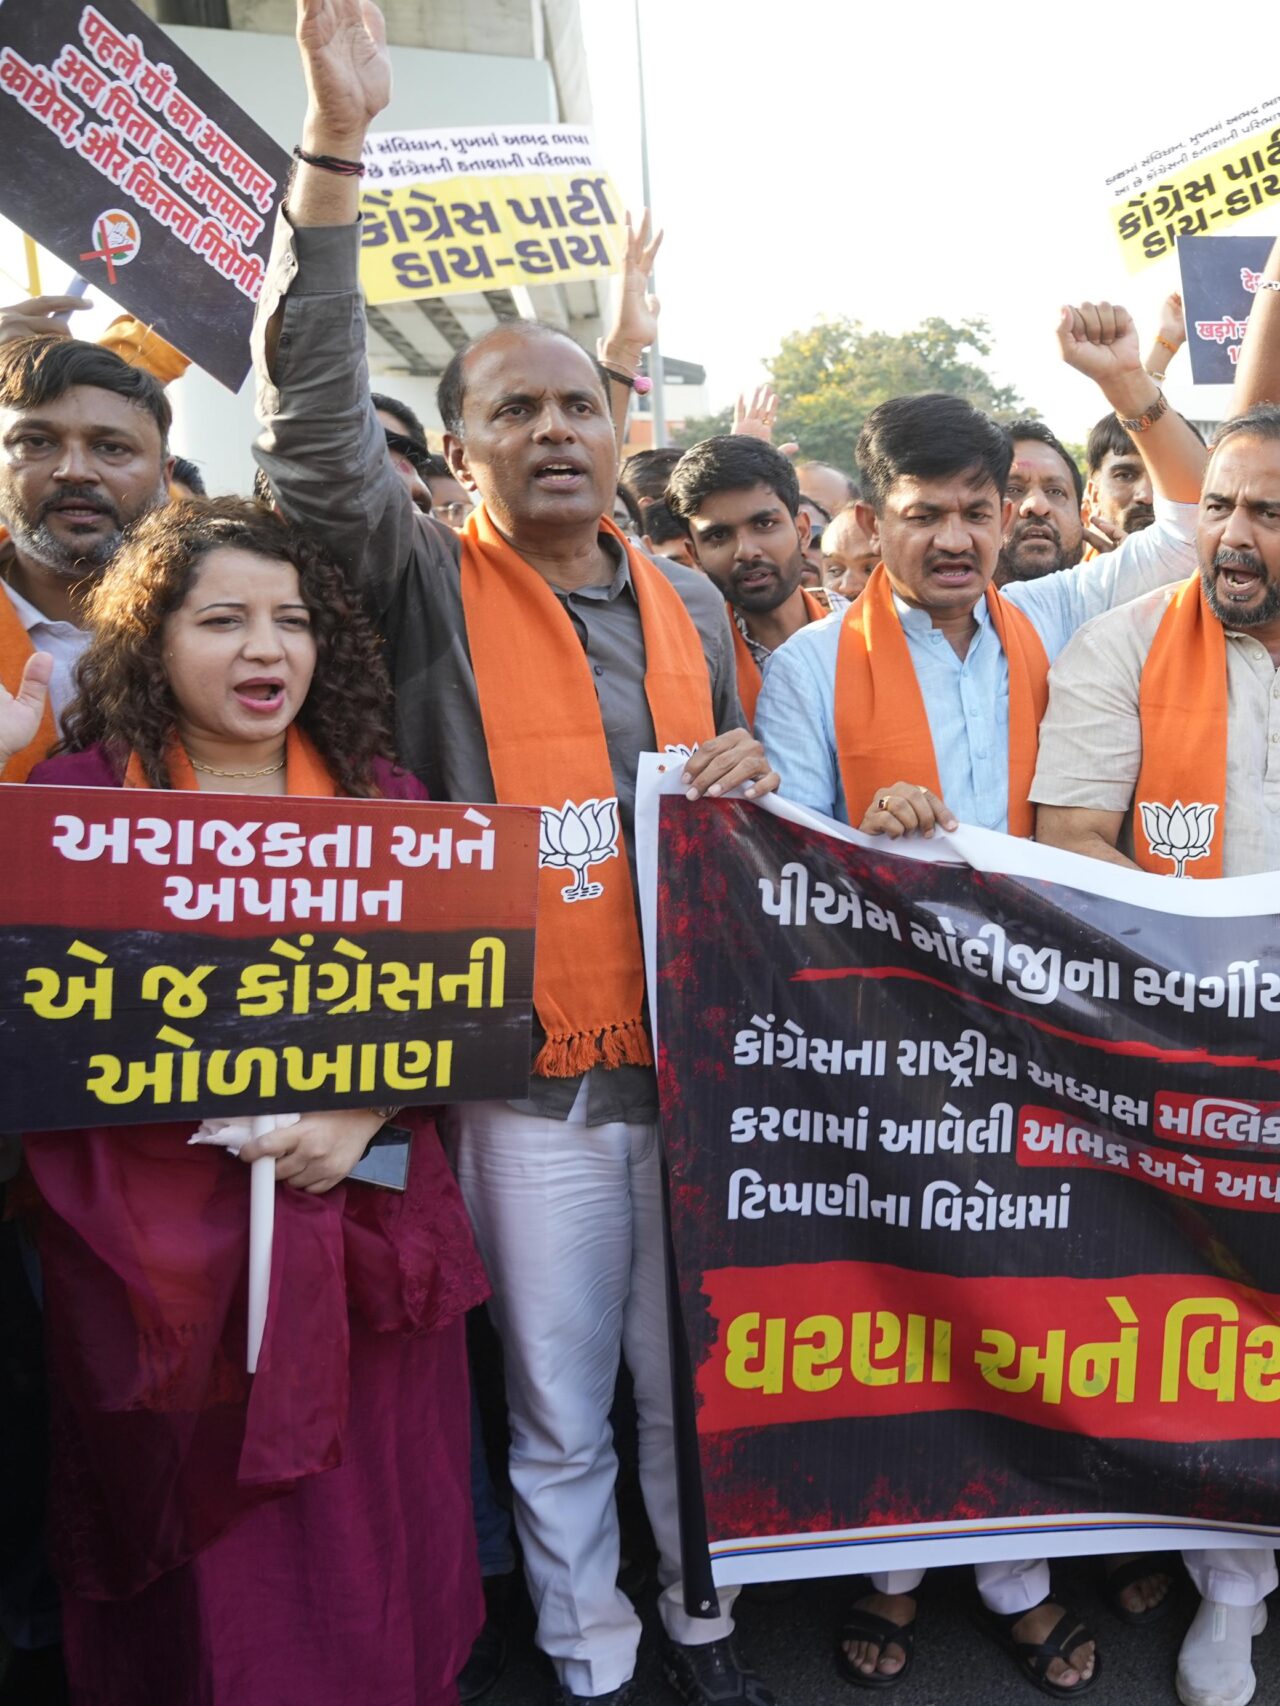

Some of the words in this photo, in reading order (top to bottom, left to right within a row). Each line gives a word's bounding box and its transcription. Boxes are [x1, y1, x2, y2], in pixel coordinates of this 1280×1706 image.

[1, 52, 81, 144] कांग्रेस,
[80, 126, 130, 179] और
[124, 160, 200, 240] कितना
[56, 49, 107, 104] अब
[101, 83, 157, 150] पिता
[153, 135, 193, 179] का
[184, 165, 262, 244] अपमान
[80, 9, 141, 80] पहले
[137, 65, 175, 107] माँ
[166, 91, 203, 141] का
[196, 124, 273, 210] अपमान,
[452, 133, 499, 154] મુખમાં
[552, 134, 589, 147] ભાષા
[526, 151, 592, 168] પરિભાષા
[361, 189, 502, 247] કોંગ્રેસ
[506, 178, 617, 229] પાર્ટી
[1118, 173, 1216, 241] કોંગ્રેસ
[392, 234, 611, 289] હાય-હાય
[1197, 317, 1238, 342] खड़गे
[52, 815, 373, 870] અરાજકતા
[390, 808, 496, 870] અને
[163, 876, 403, 922] અપમાન
[758, 862, 902, 941] પીએમ
[910, 916, 1120, 1004] મોદીજીના
[24, 939, 114, 1020] એ
[141, 964, 218, 1018] જ
[236, 934, 506, 1015] કોંગ્રેસની
[87, 1025, 454, 1104] ઓળખાણ
[733, 1013, 887, 1076] કોંગ્રેસના
[897, 1028, 1017, 1087] રાષ્ટ્રીય
[1027, 1060, 1148, 1127] અધ્યક્ષ
[730, 1106, 869, 1151] કરવામાં
[879, 1102, 1013, 1154] આવેલી
[1023, 1119, 1129, 1169] અભદ્ર
[1138, 1153, 1204, 1194] અને
[727, 1167, 911, 1228] ટિપ્પણીના
[920, 1180, 1071, 1231] વિરોધમાં
[725, 1311, 952, 1395] ધરણા
[974, 1296, 1139, 1404] અને
